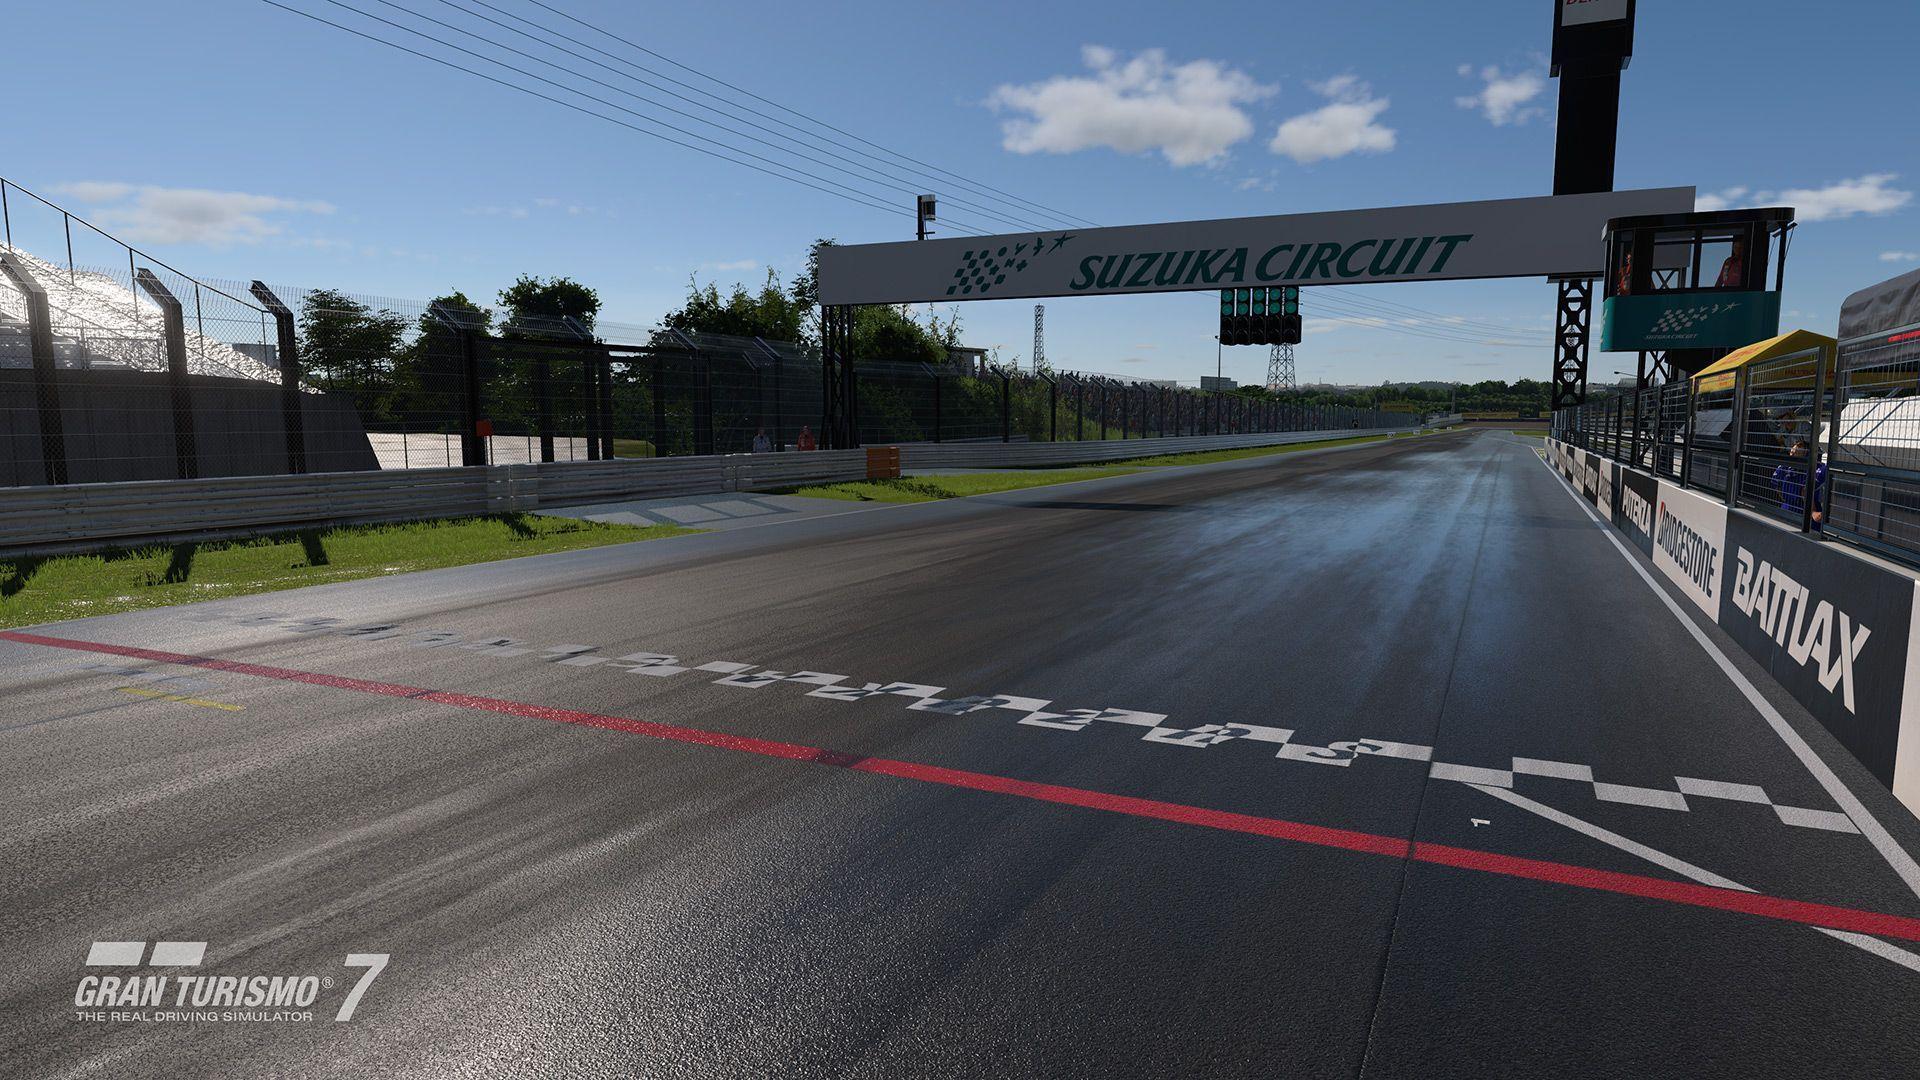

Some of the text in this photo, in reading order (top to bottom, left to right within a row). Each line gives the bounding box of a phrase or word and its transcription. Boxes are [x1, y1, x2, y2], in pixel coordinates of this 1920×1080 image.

[1070, 236, 1472, 290] SUZUKA CIRCUIT
[1622, 484, 1651, 538] POTENZA
[1657, 501, 1717, 599] BRIDGESTONE
[1733, 546, 1872, 715] BATTLAX
